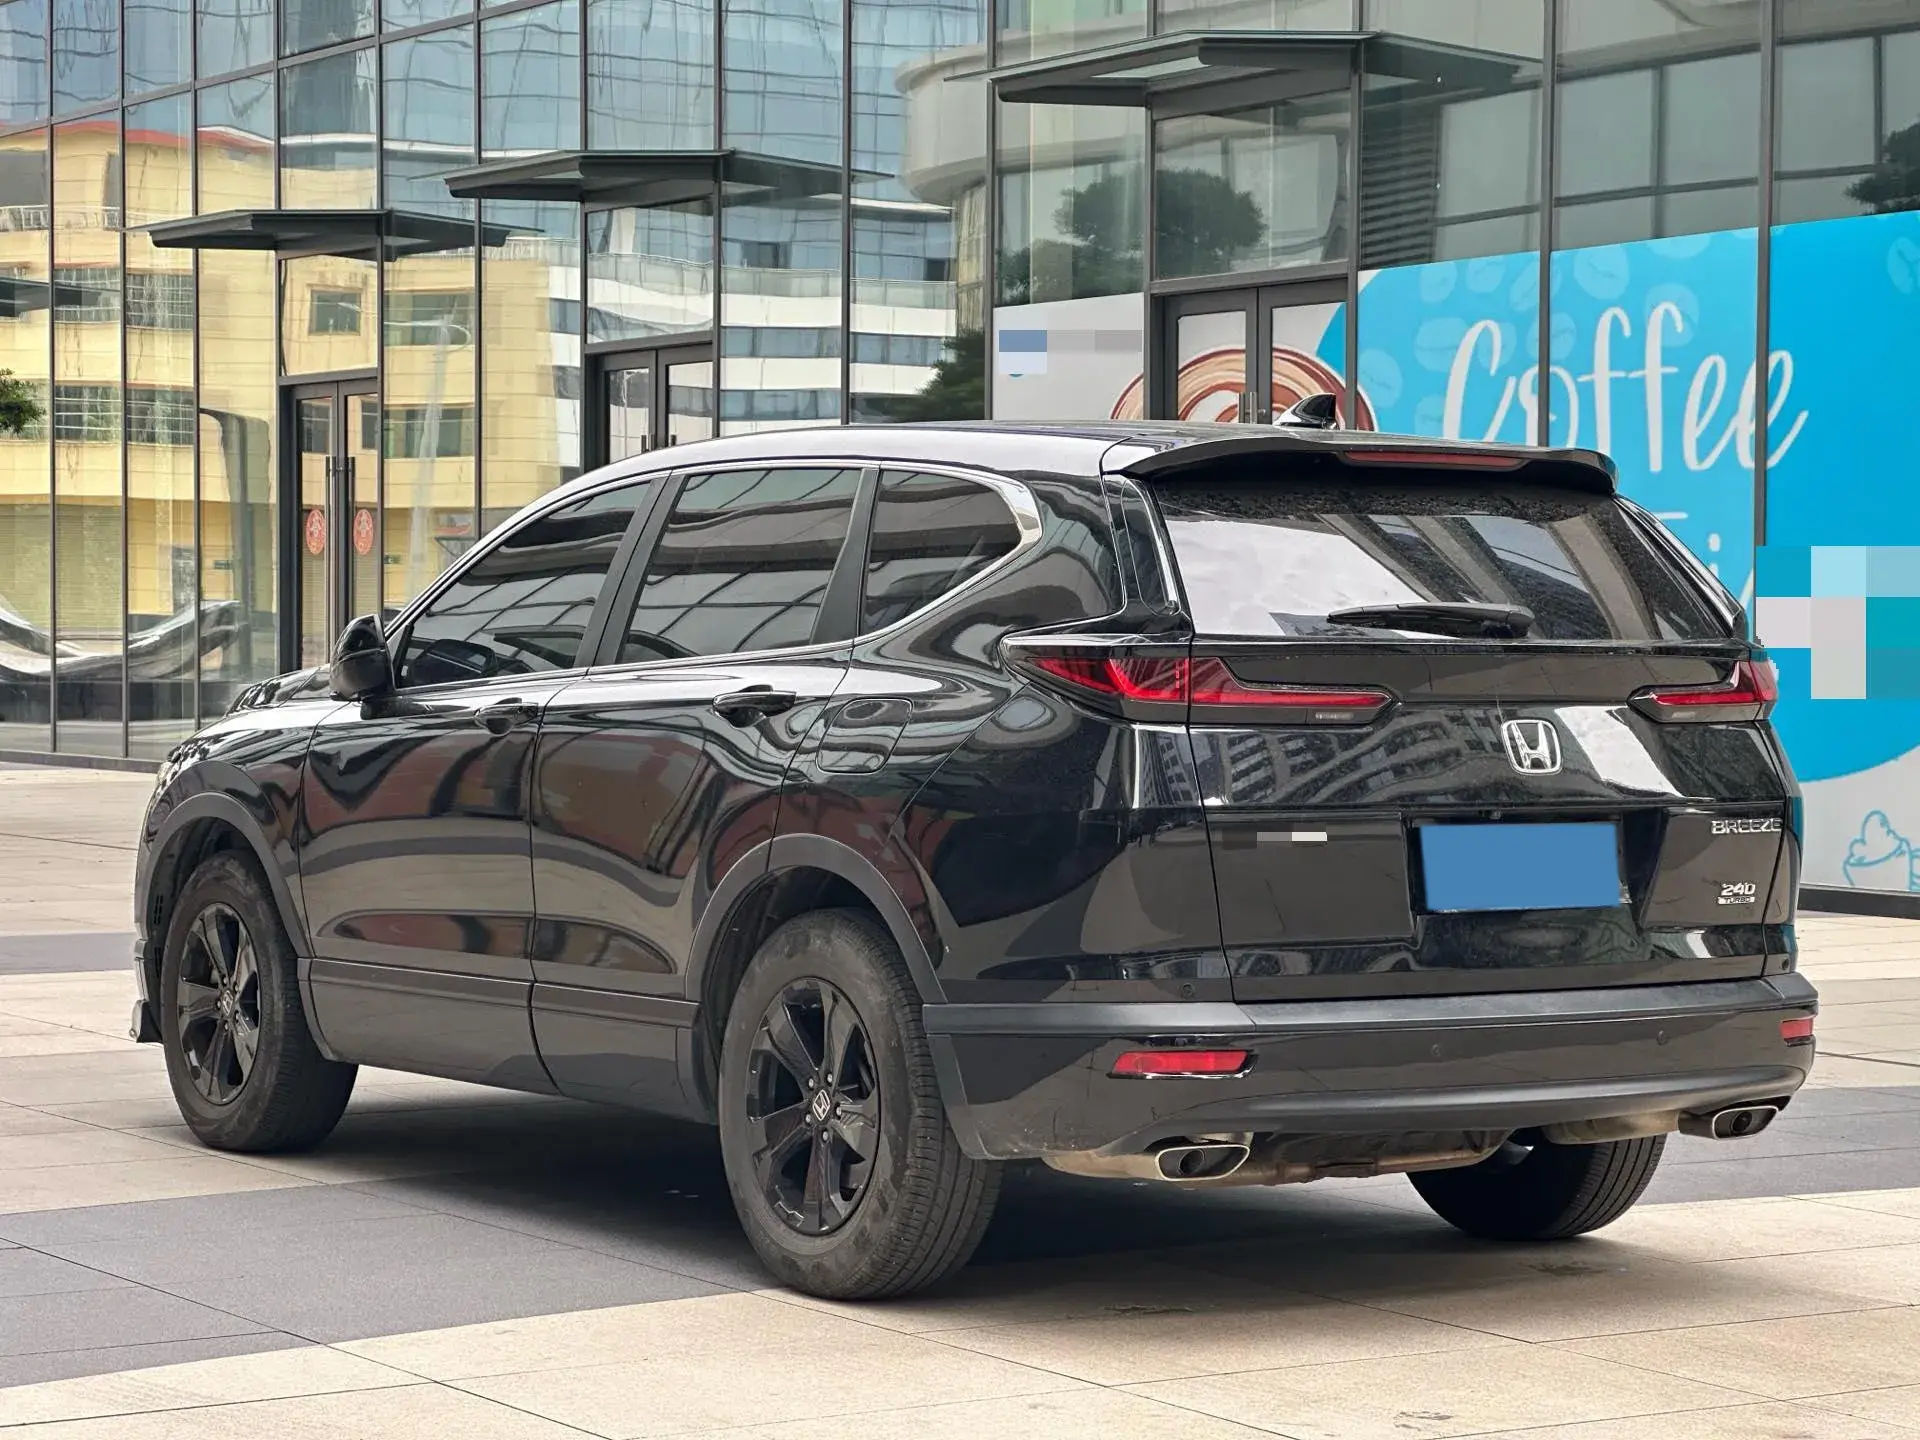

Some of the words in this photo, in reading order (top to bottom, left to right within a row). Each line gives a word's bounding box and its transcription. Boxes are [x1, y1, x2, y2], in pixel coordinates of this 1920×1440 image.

[1443, 302, 1809, 472] Coffee
[1711, 818, 1782, 834] BREEZE
[1721, 882, 1756, 896] 240
